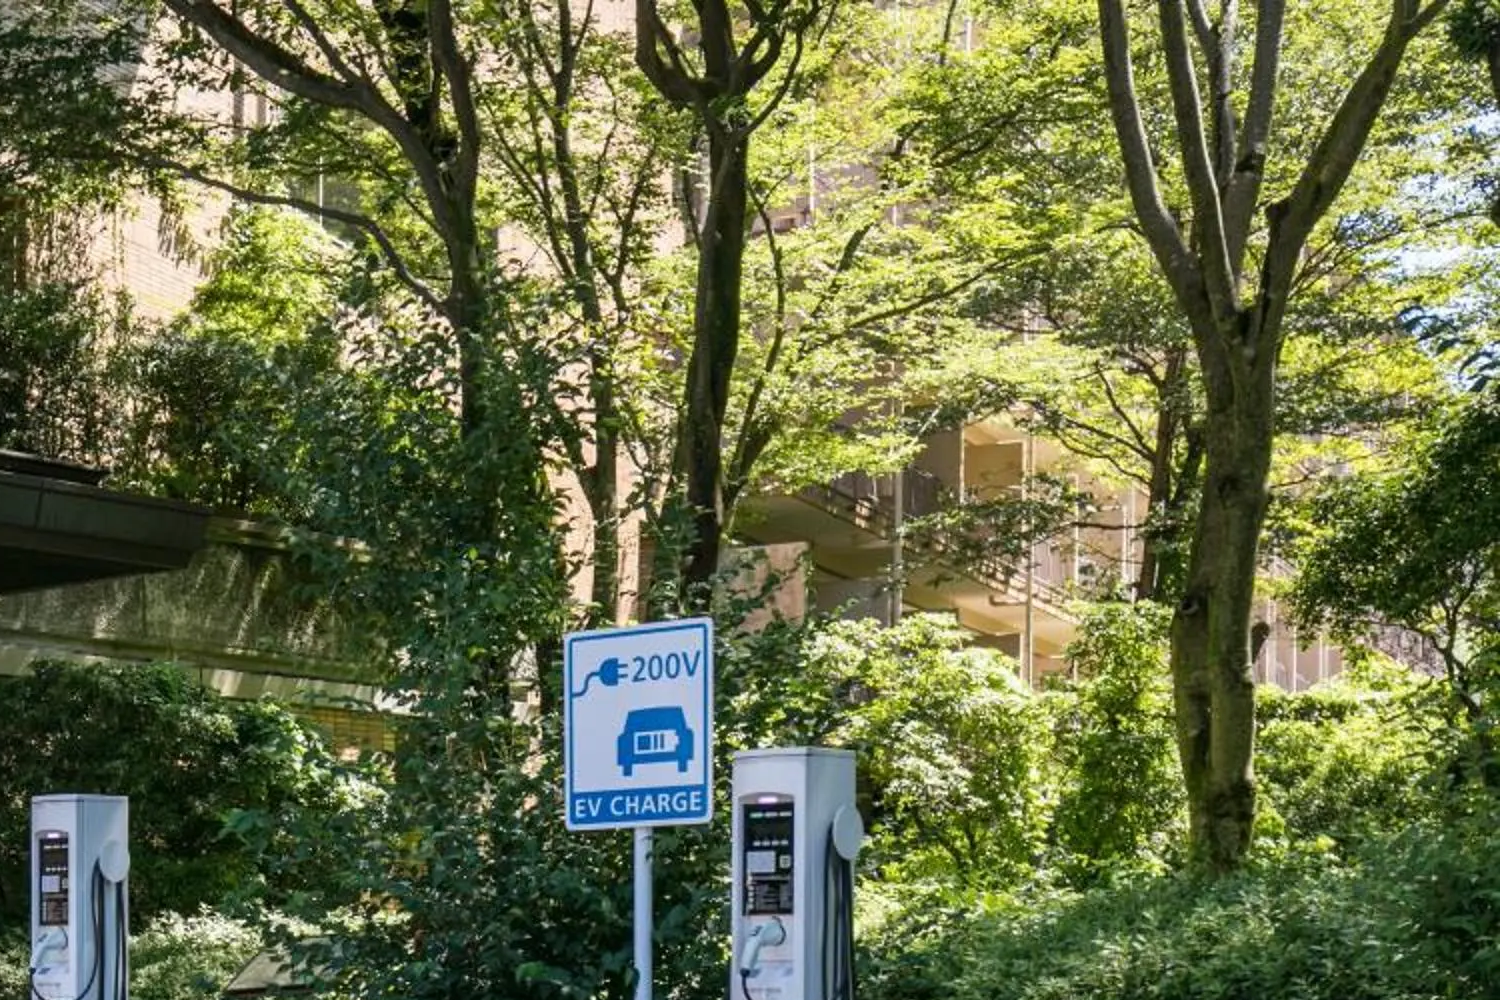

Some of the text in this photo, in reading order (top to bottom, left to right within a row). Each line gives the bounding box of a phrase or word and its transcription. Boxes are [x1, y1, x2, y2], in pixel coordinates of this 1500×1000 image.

[632, 651, 700, 682] 200V
[575, 791, 702, 818] EV CHARGE
